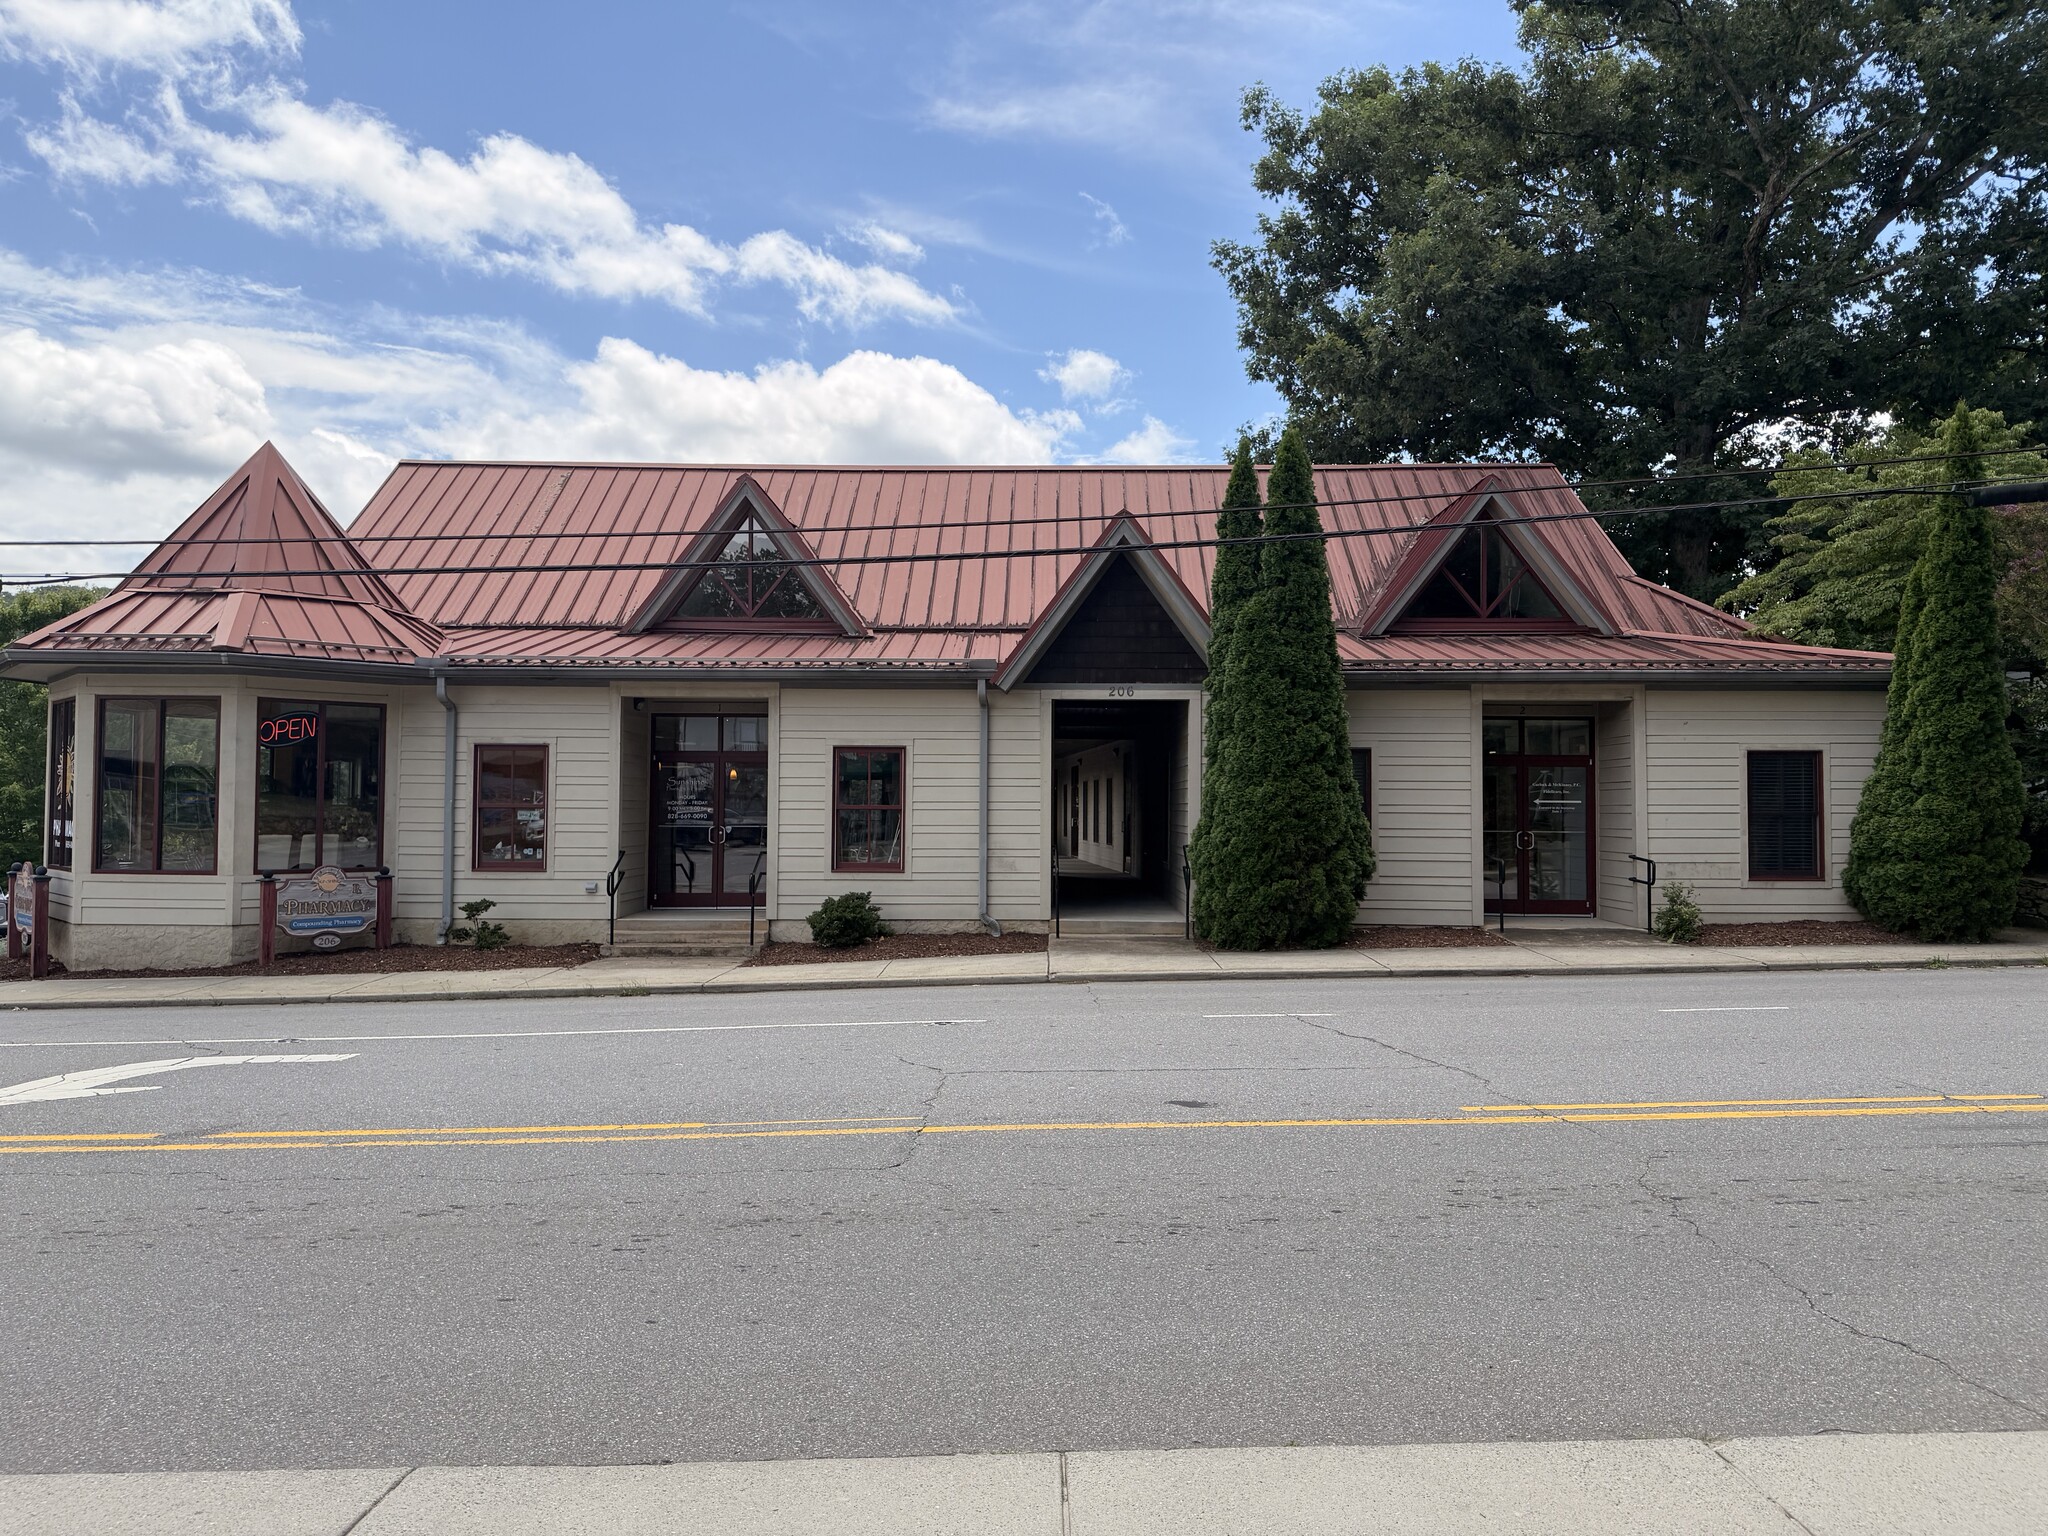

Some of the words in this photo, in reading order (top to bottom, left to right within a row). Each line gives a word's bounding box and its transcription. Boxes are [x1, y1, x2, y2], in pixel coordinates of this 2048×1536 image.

[1108, 686, 1134, 697] 206
[1519, 706, 1526, 715] 2
[260, 717, 316, 742] OPEN
[292, 920, 333, 928] Compounding
[318, 937, 336, 945] 206
